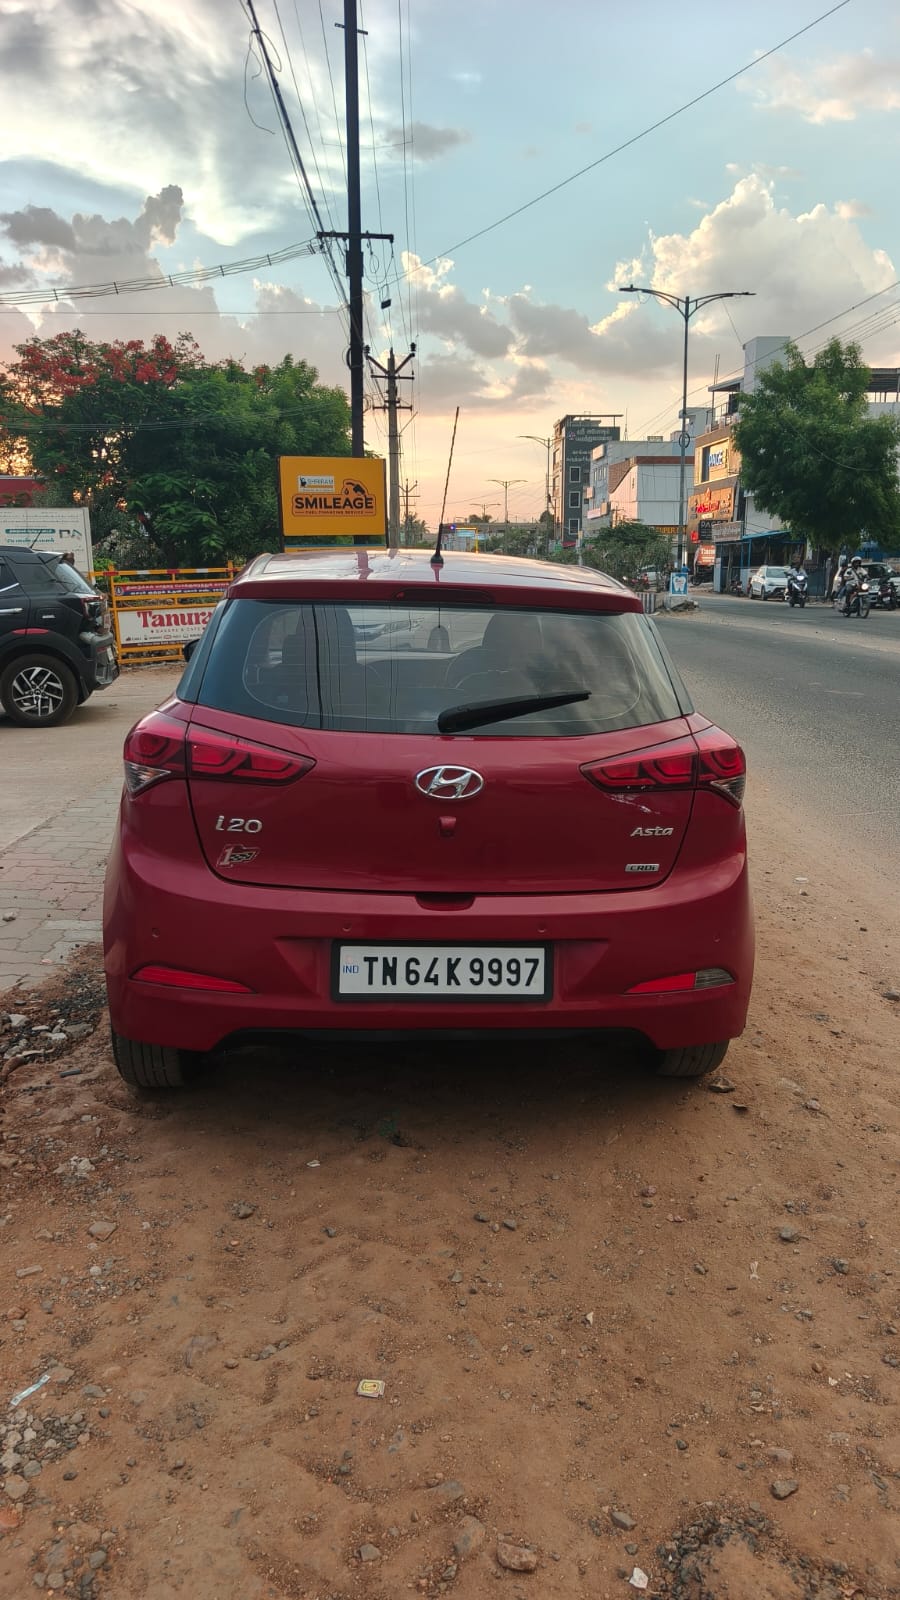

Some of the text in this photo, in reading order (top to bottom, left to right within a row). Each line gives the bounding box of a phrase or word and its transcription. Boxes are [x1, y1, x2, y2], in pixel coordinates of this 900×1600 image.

[295, 497, 374, 509] SMILEAGE
[215, 815, 263, 833] i20
[630, 826, 674, 837] Asta
[342, 965, 359, 974] IND
